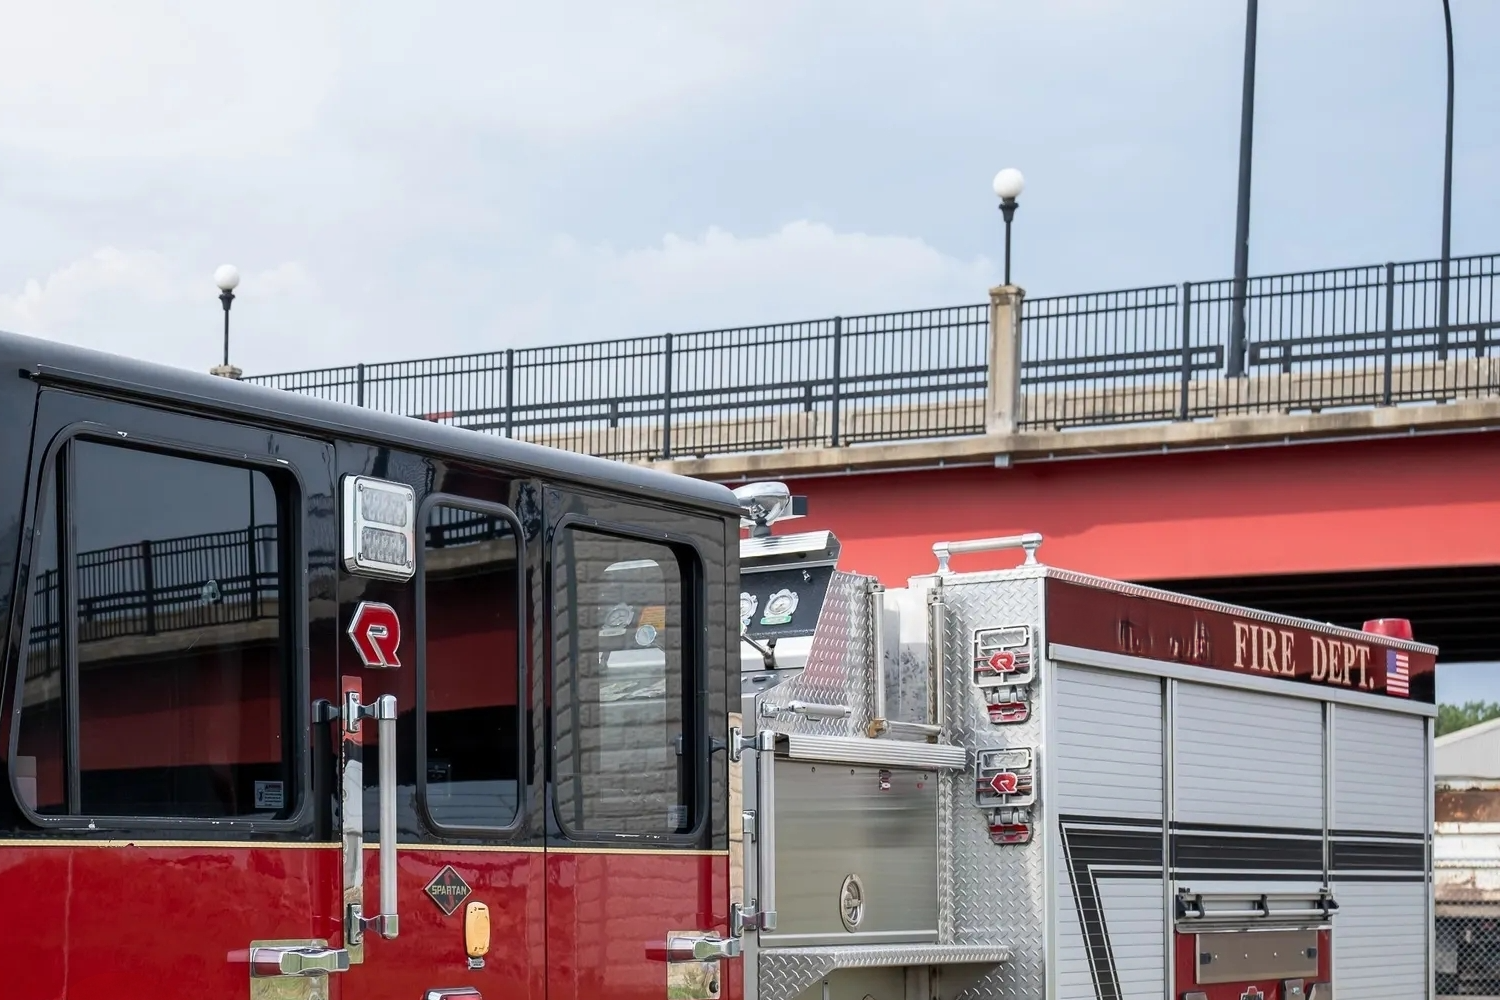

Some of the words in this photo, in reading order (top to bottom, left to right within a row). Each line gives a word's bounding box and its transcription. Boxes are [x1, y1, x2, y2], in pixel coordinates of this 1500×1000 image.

[1233, 621, 1296, 677] FIRE
[1310, 636, 1375, 690] DEPT.
[431, 885, 467, 895] SPARTAN
